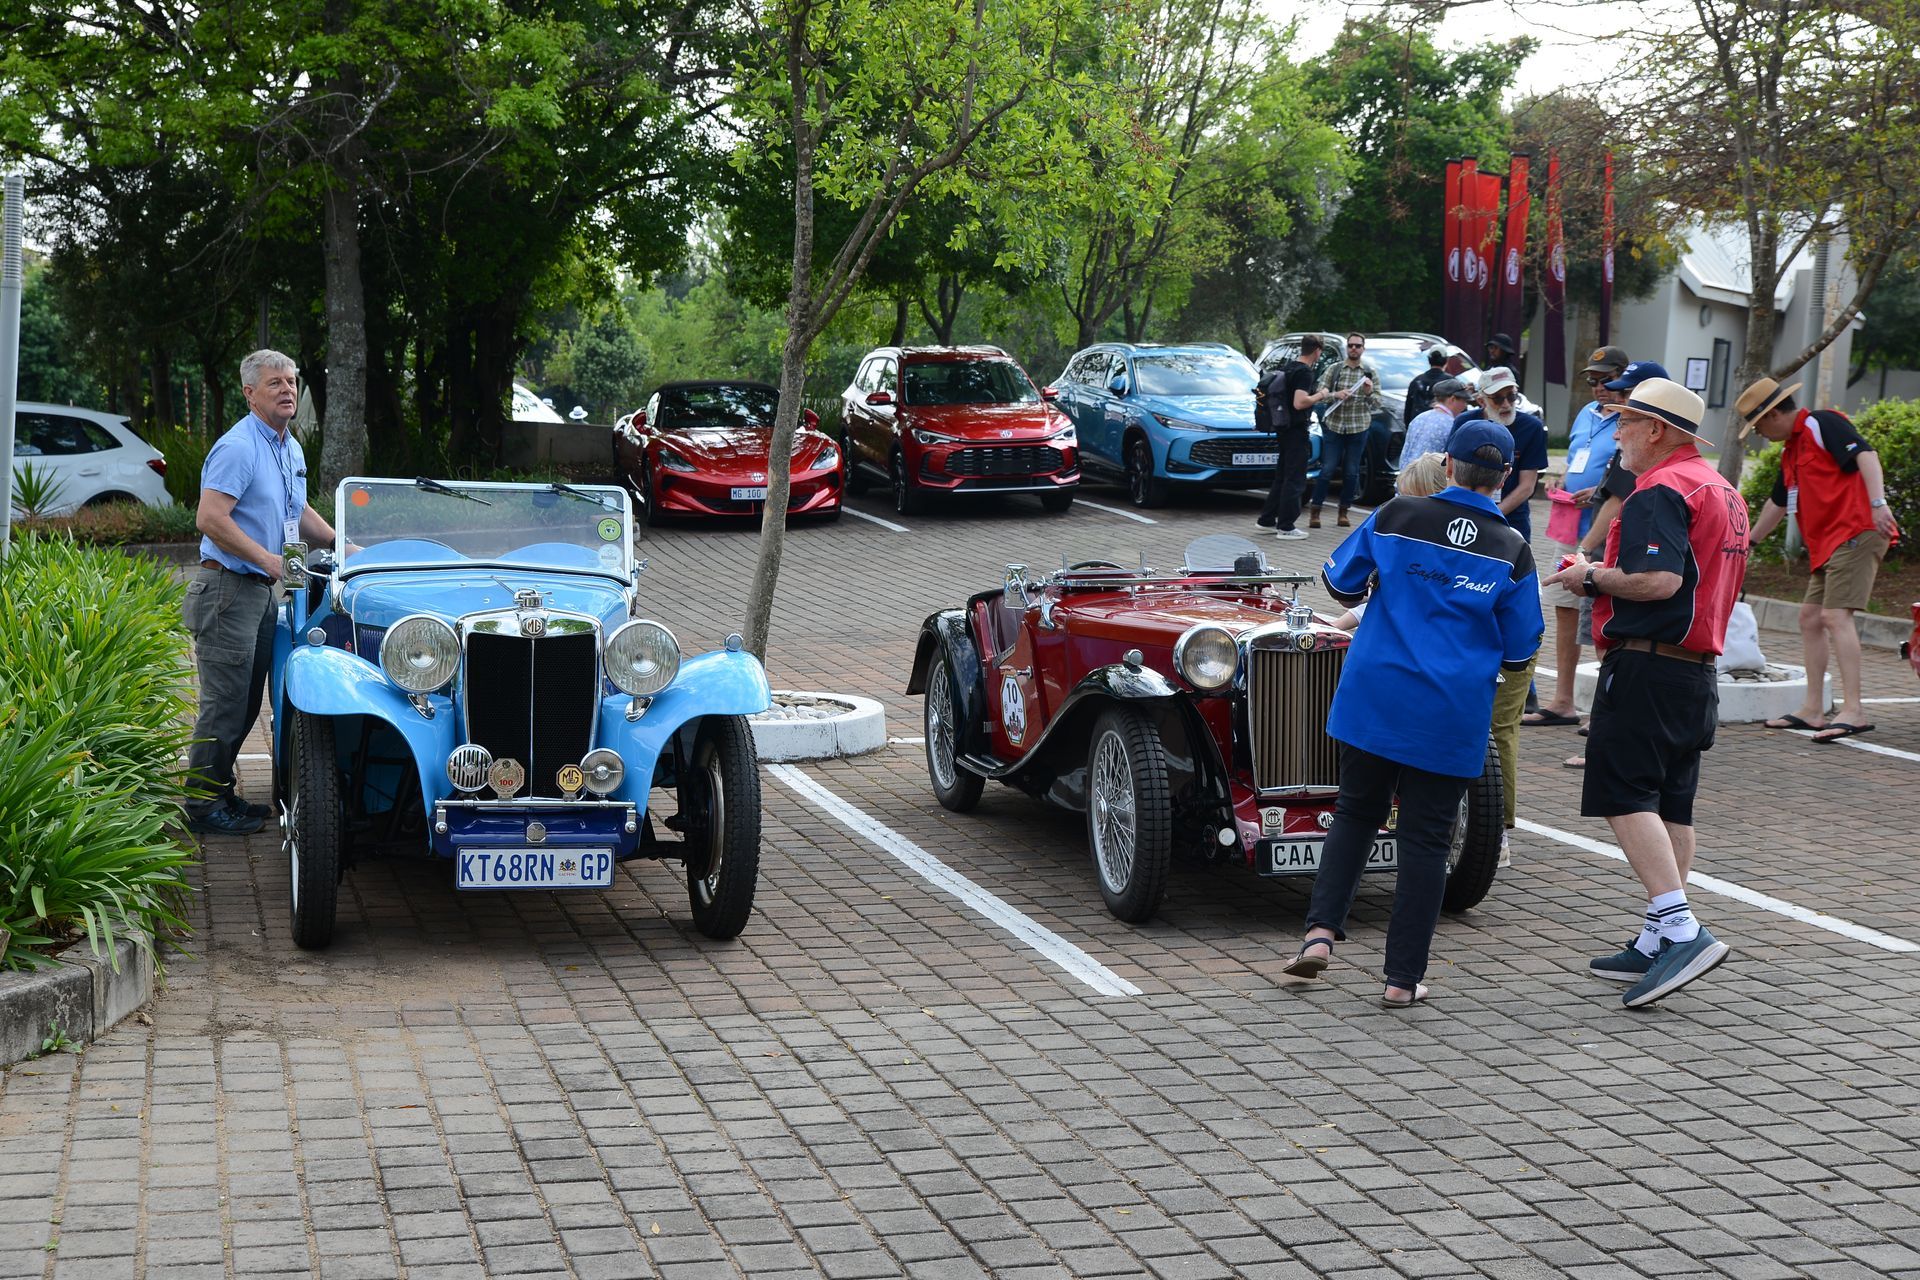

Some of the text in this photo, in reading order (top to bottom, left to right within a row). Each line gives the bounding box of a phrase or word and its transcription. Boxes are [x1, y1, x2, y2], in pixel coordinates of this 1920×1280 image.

[732, 489, 761, 498] MG 100
[1448, 519, 1477, 546] MG
[1406, 562, 1496, 594] Safety Fast!
[527, 619, 542, 634] MG
[1301, 634, 1314, 648] MG
[1006, 682, 1018, 704] 10
[563, 769, 580, 784] MG
[1320, 814, 1334, 828] MG
[1274, 844, 1315, 866] CAA
[461, 854, 554, 882] KT68RN
[580, 853, 609, 881] GP
